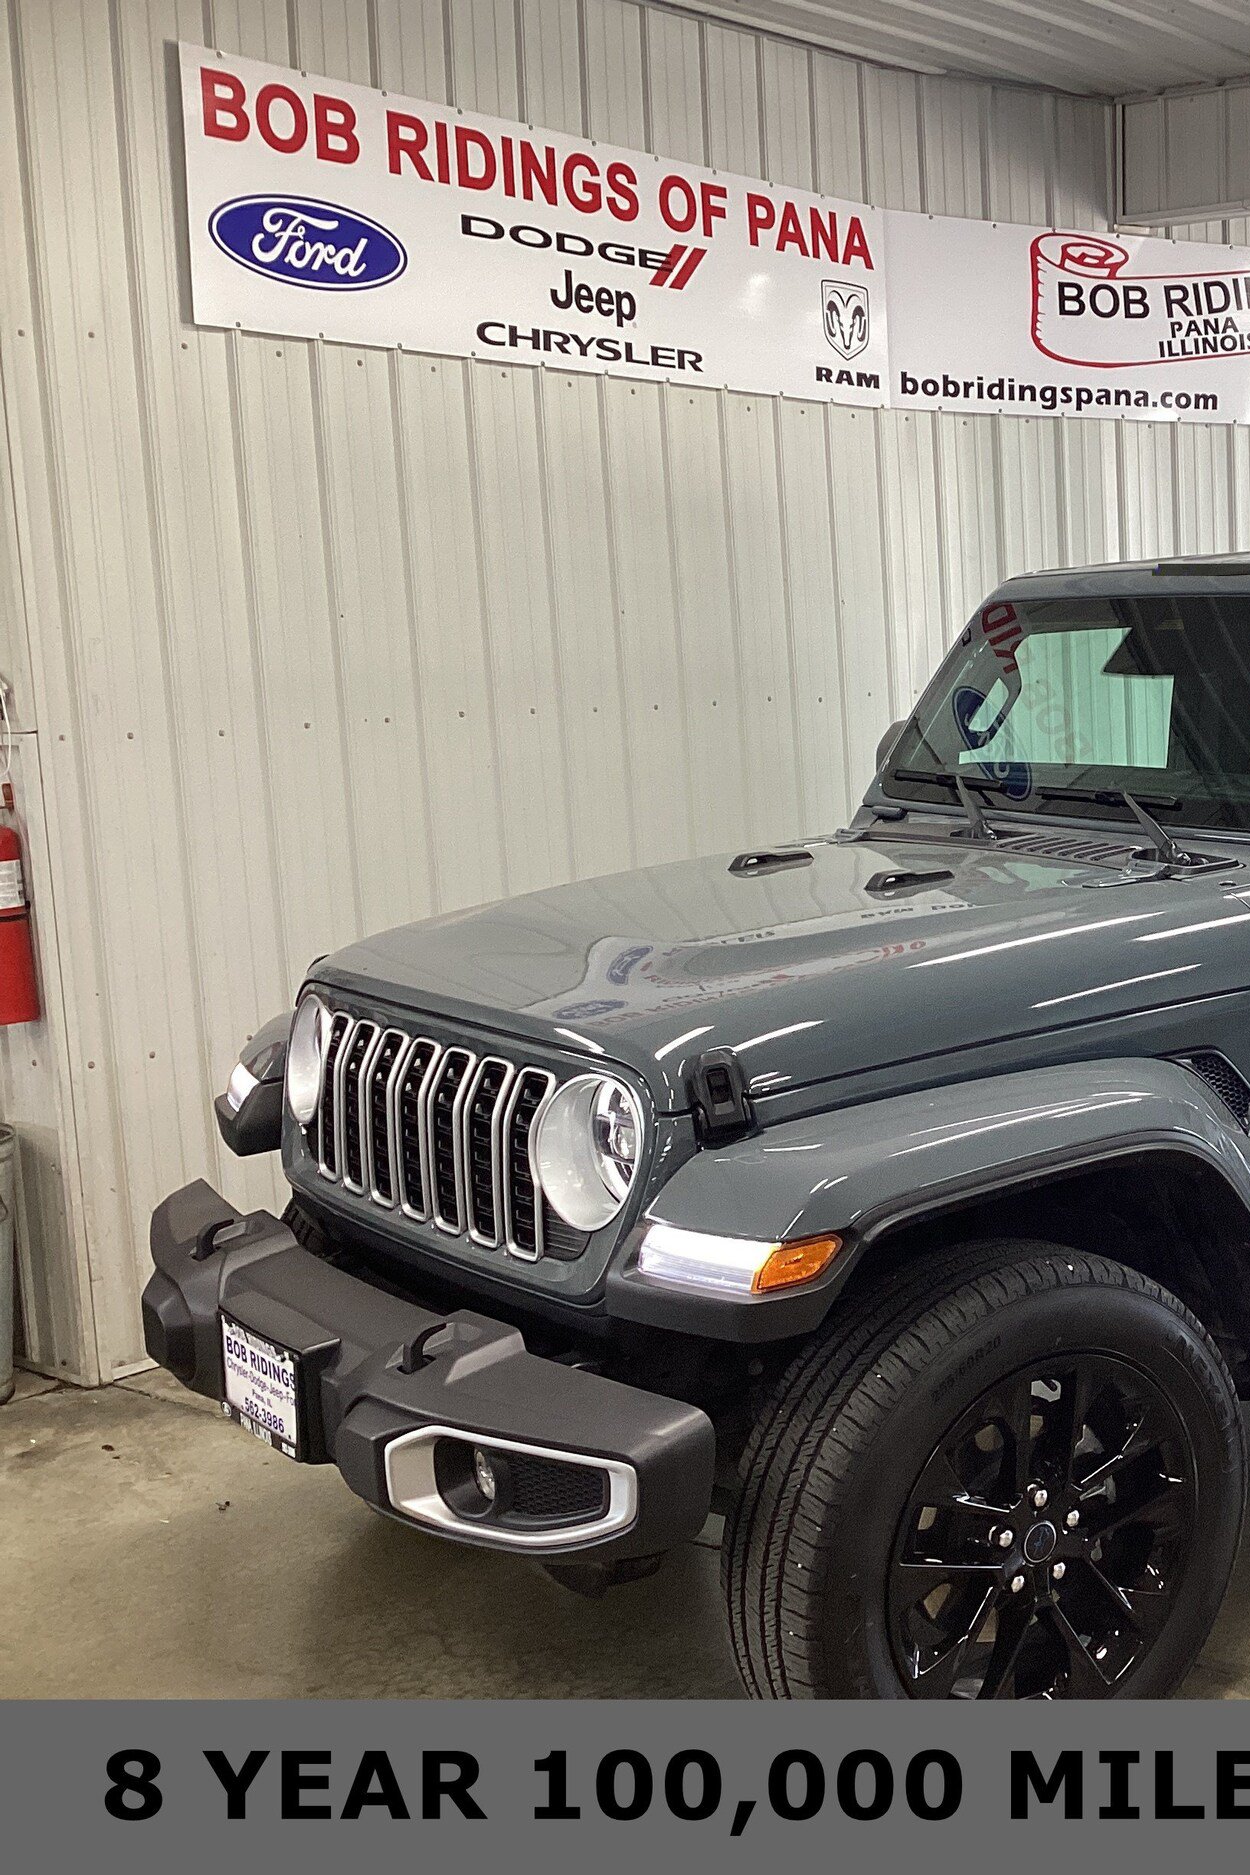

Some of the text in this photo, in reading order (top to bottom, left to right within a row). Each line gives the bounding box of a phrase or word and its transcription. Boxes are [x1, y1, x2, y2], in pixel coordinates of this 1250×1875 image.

[201, 67, 875, 270] BOB RIDINGS OF PANA
[252, 207, 368, 277] Ford
[461, 214, 674, 272] DODGE
[550, 270, 637, 328] Jeep
[1057, 281, 1150, 319] BOB
[476, 321, 704, 373] CHRYSLER
[1170, 316, 1240, 338] PANA
[816, 366, 883, 390] RAM
[900, 371, 1219, 412] bobridingspana.com
[226, 1335, 248, 1363] BOB
[249, 1350, 296, 1391] RIDINGS
[244, 1397, 285, 1434] 562-3986
